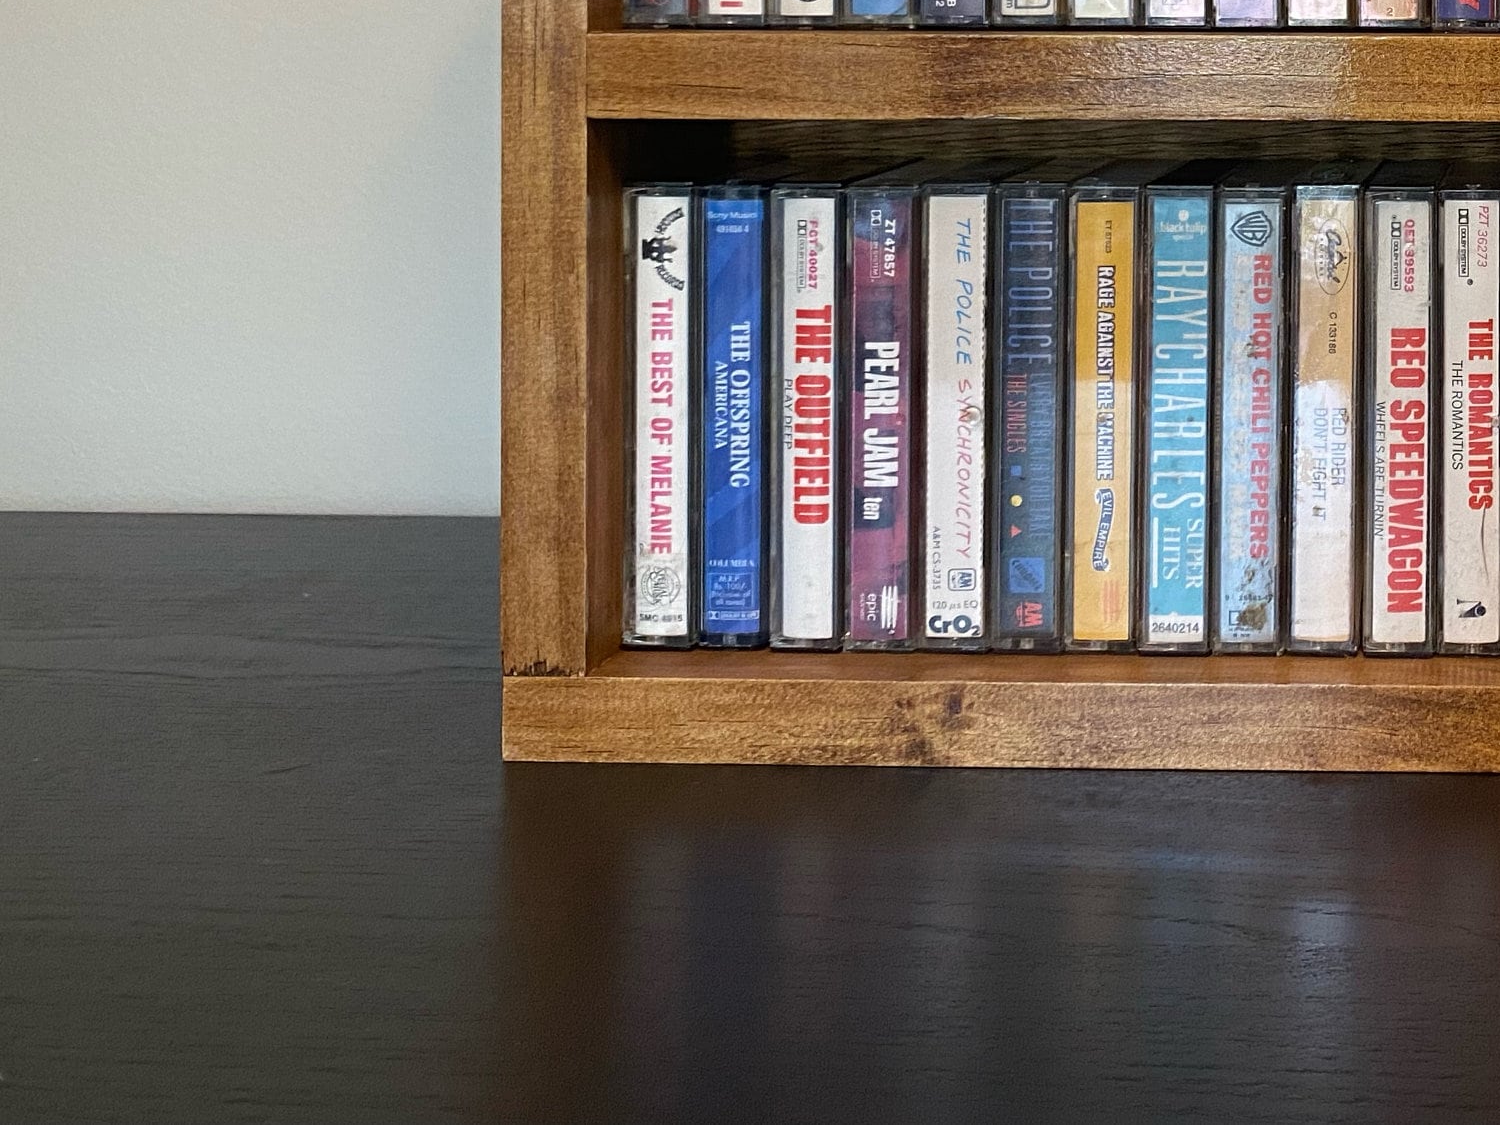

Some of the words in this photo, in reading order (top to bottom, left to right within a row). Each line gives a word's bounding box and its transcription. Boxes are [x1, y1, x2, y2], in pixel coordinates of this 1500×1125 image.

[885, 219, 895, 235] ZT
[1009, 200, 1052, 252] THE
[1478, 205, 1489, 227] PZT
[884, 238, 895, 277] 47857
[956, 218, 971, 272] THE
[1476, 230, 1488, 267] 36273
[1097, 265, 1114, 308] RAGE
[1157, 261, 1207, 323] RAY
[1253, 254, 1272, 304] RED
[651, 298, 673, 341] THE
[731, 321, 750, 362] THE
[795, 305, 831, 364] THE
[955, 279, 972, 365] POLICE
[1008, 267, 1052, 365] POLICE
[1253, 312, 1271, 359] HOT
[1469, 319, 1493, 360] THE
[1097, 312, 1113, 376] AGAINST
[1389, 328, 1425, 389] REO
[651, 352, 673, 406] BEST
[864, 342, 900, 420] PEARL
[1006, 373, 1027, 395] THE
[1097, 381, 1113, 409] THE
[1252, 368, 1271, 432] CHILI
[1452, 361, 1464, 387] THE
[651, 417, 673, 445] OF
[715, 361, 728, 449] AMERICANA
[730, 369, 750, 488] OFFSPRING
[1006, 401, 1027, 453] SINGLES
[1153, 343, 1206, 508] CHARLES
[1332, 408, 1346, 436] RED
[1452, 391, 1463, 470] ROMANTICS
[794, 375, 830, 524] OUTFIELD
[864, 428, 898, 487] JAM
[1097, 414, 1113, 480] MACHINE
[1331, 442, 1345, 485] RIDER
[1468, 373, 1493, 510] ROMANTICS
[955, 379, 972, 558] SYNCHRONICITY
[651, 455, 673, 554] MELANIE
[863, 497, 883, 519] ten
[1250, 443, 1270, 559] PEPPERS
[1386, 400, 1425, 613] SPEEDWAGON
[932, 526, 941, 550] A&M
[1162, 527, 1180, 580] HITS
[1185, 518, 1203, 588] SUPER
[932, 552, 941, 589] CS-3735
[865, 593, 878, 620] epic
[1152, 622, 1199, 634] 2640214
